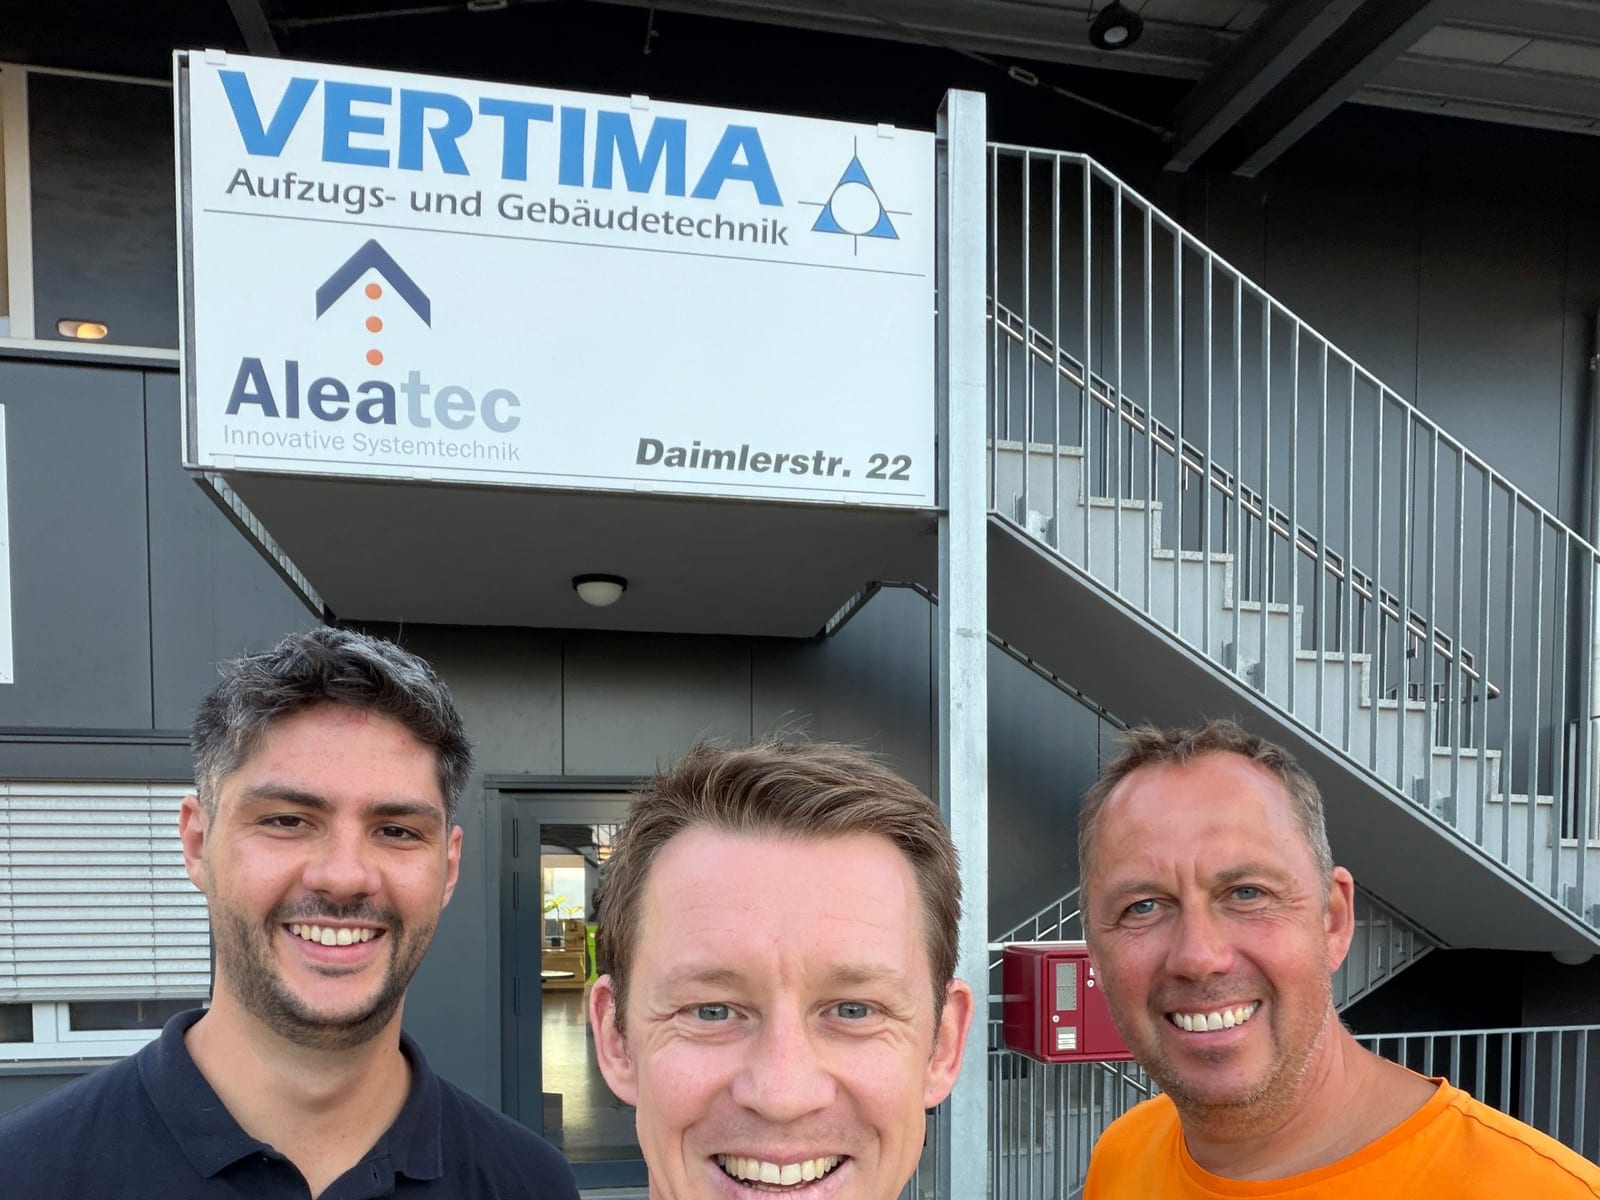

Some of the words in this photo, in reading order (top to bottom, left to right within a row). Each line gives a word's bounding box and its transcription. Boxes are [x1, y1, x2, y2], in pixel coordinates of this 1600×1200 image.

[219, 71, 783, 206] VERTIMA
[226, 169, 396, 214] Aufzugs-
[411, 190, 482, 216] und
[499, 194, 788, 245] Gebäudetechnik
[226, 357, 521, 432] Aleatec
[224, 425, 345, 450] Innovative
[353, 433, 520, 461] Systemtechnik
[637, 438, 851, 477] Daimlerstr.
[866, 454, 912, 480] 22
